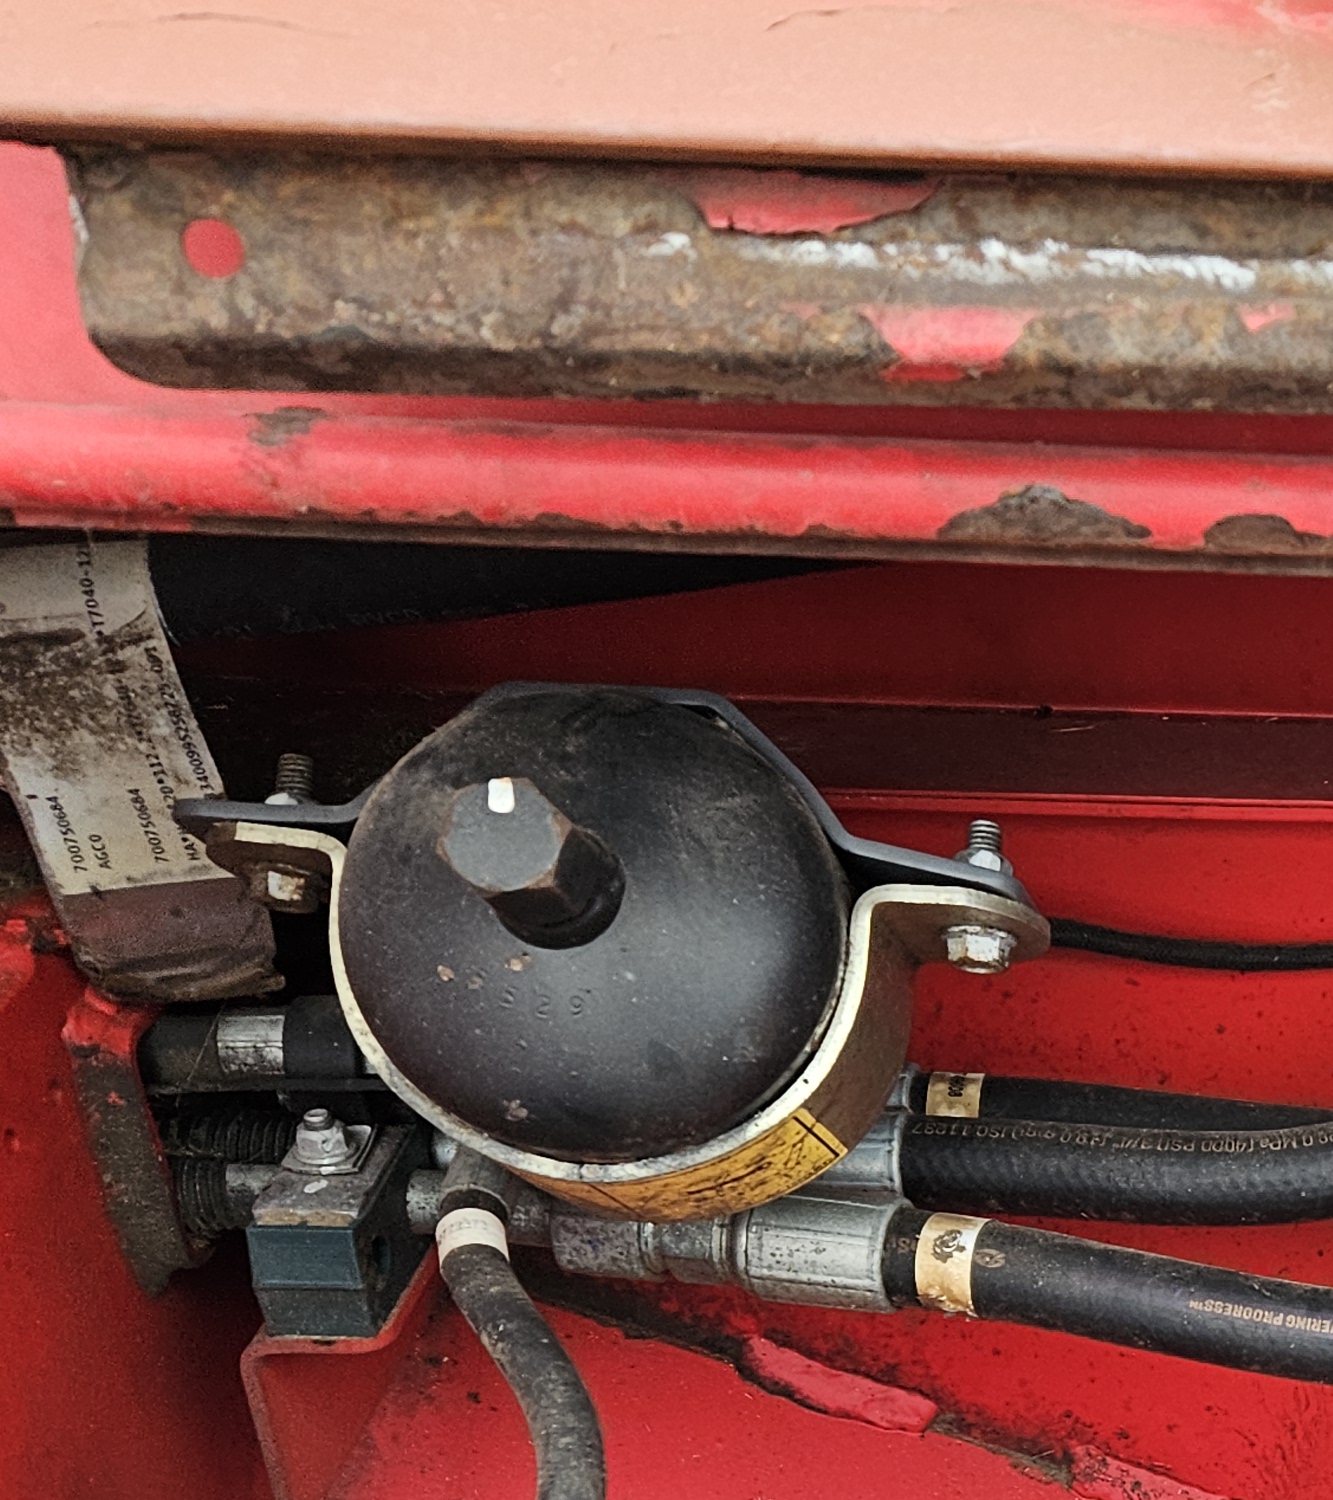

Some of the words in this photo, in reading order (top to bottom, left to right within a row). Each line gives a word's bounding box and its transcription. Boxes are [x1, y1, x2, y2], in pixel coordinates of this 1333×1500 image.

[45, 795, 88, 874] 700750684
[88, 833, 112, 871] AGCO
[127, 787, 169, 864] 700750684
